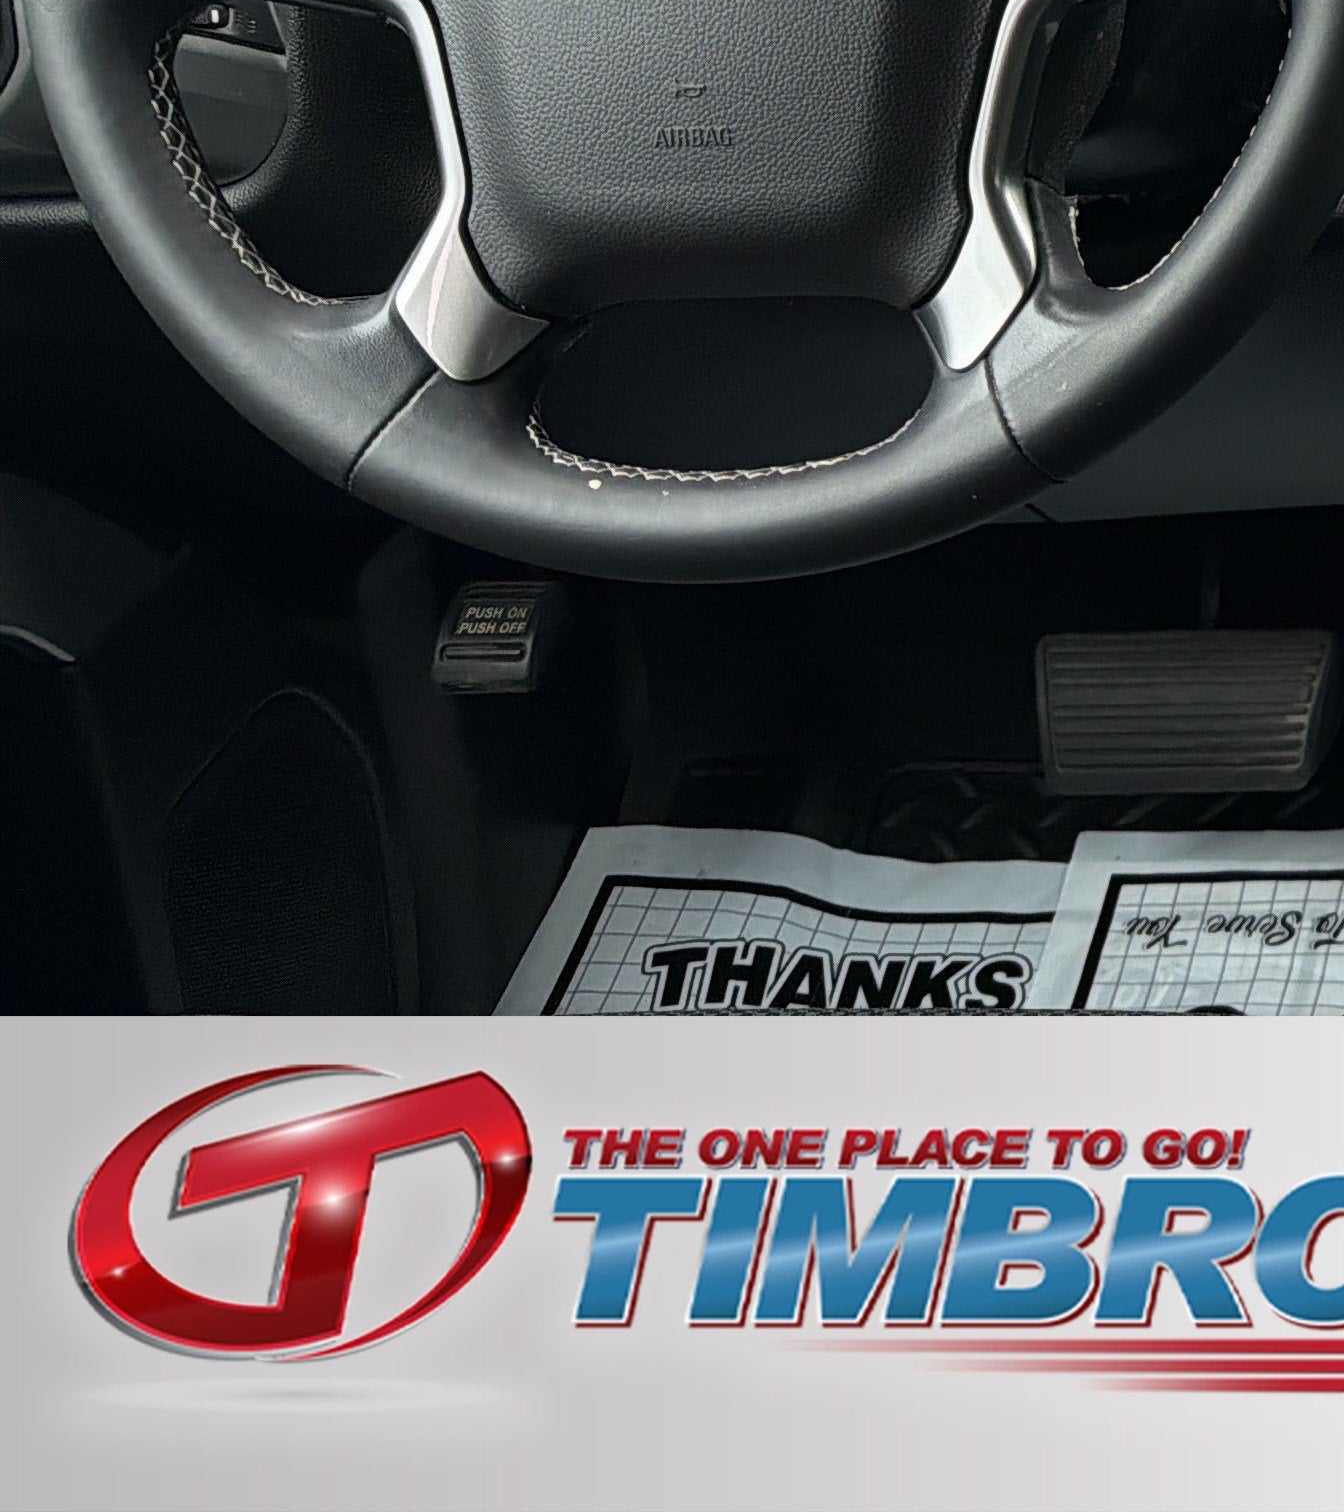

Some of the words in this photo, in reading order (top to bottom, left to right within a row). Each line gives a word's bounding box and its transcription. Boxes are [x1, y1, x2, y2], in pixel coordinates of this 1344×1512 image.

[653, 126, 733, 149] AIRBAG
[456, 621, 498, 634] PUSH
[499, 621, 527, 634] OFF
[465, 606, 504, 619] PUSH
[507, 606, 529, 619] ON
[1125, 913, 1188, 950] You
[1204, 910, 1303, 947] Serve
[643, 939, 1032, 1010] THANKS
